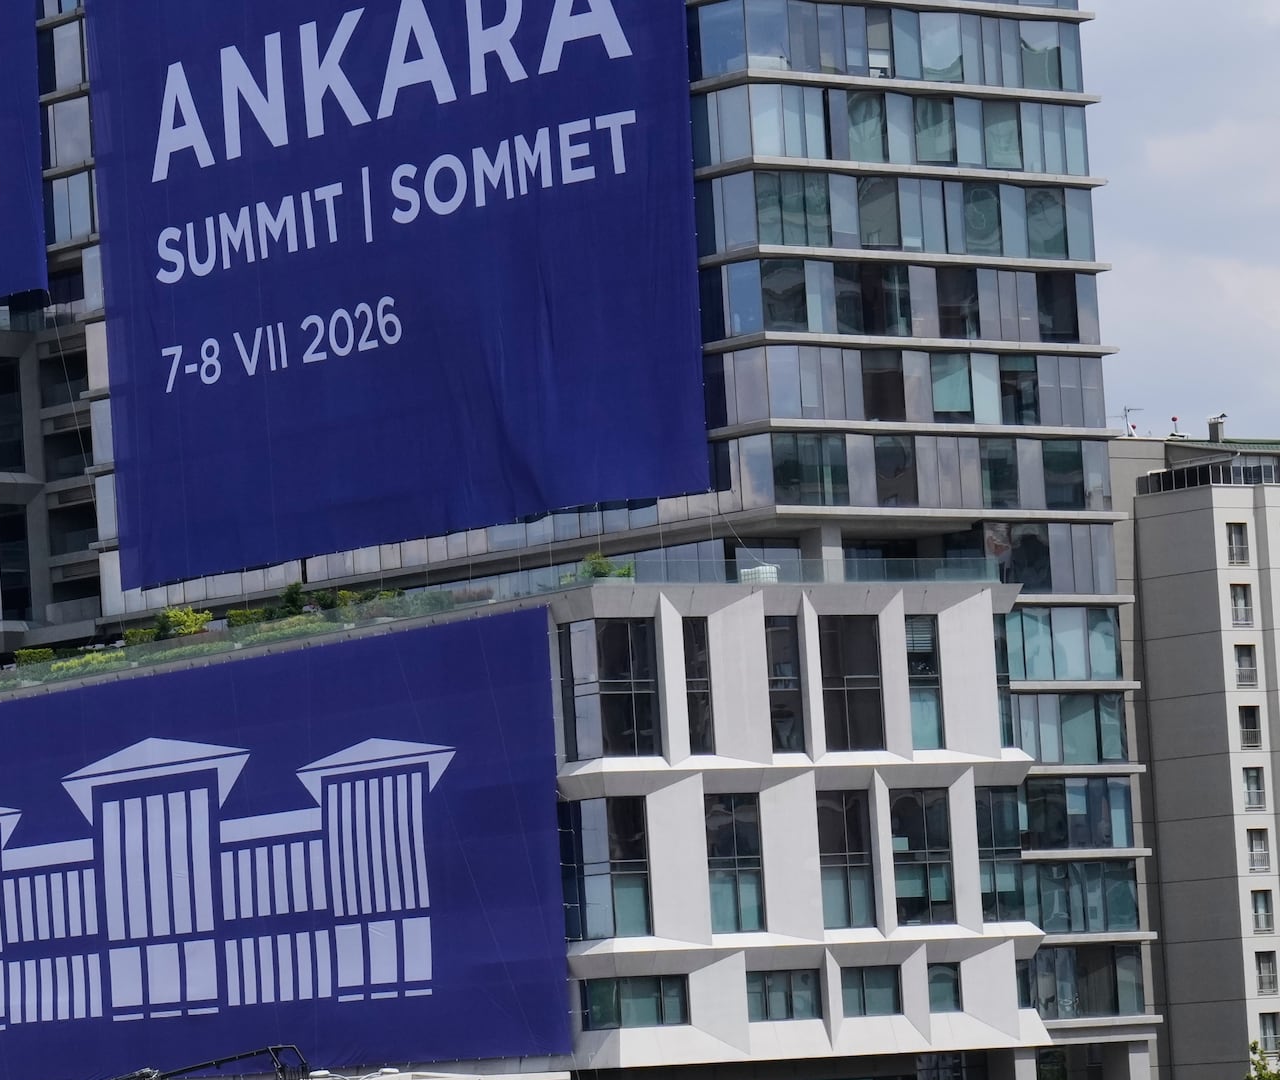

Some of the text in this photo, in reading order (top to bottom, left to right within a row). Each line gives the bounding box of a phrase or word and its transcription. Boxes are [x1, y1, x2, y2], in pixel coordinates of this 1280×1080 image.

[151, 0, 633, 182] ANKARA
[156, 182, 343, 284] SUMMIT
[391, 109, 638, 225] SOMMET
[161, 295, 404, 394] 7-8 VII 2026
